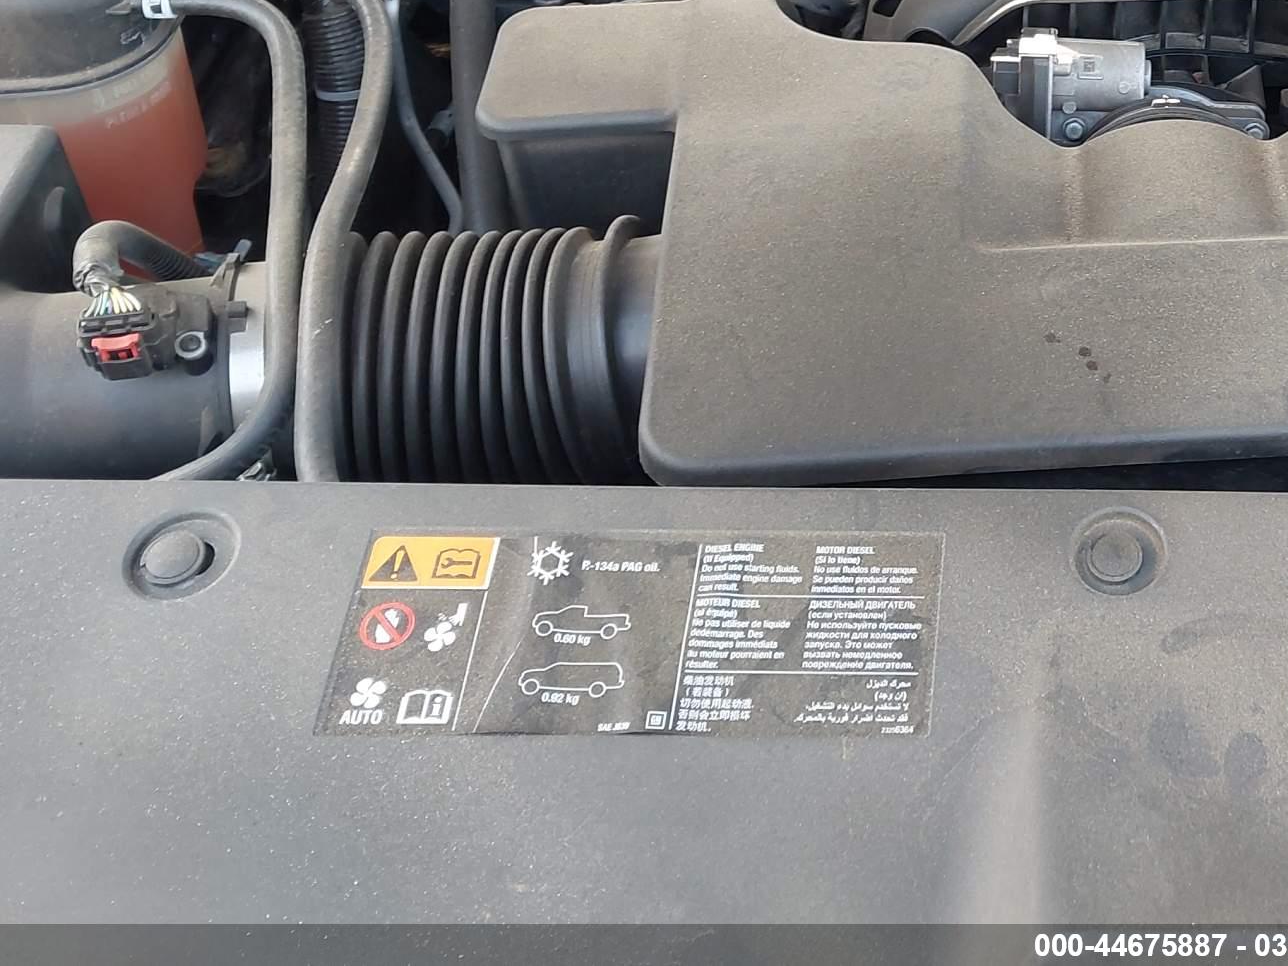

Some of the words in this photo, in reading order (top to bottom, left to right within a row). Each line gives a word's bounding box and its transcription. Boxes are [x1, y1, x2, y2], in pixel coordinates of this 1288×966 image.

[704, 544, 732, 553] DIESEL
[734, 543, 764, 552] ENGINE
[816, 546, 845, 554] MOTOR
[846, 546, 875, 554] DIESEL
[703, 554, 713, 563] (If
[714, 554, 754, 564] Equipped)
[814, 556, 826, 564] (Si
[827, 556, 836, 564] lo
[838, 556, 860, 565] tiene)
[582, 560, 620, 572] R-134a
[620, 561, 643, 572] PAG
[644, 562, 661, 572] oil.
[702, 564, 713, 572] Do
[714, 564, 727, 572] not
[744, 564, 775, 574] starting
[776, 565, 800, 573] fluids.
[842, 566, 868, 574] fluidos
[870, 566, 881, 574] de
[882, 567, 918, 576] arranque.
[700, 574, 741, 582] Immediate
[742, 575, 770, 584] engine
[770, 575, 803, 584] damage
[812, 575, 823, 583] Se
[824, 575, 854, 584] pueden
[854, 576, 889, 584] producir
[889, 575, 914, 584] daños
[714, 583, 739, 592] result.
[811, 585, 854, 593] inmediatos
[696, 598, 731, 607] MOTEUR
[731, 599, 760, 608] DIESEL
[808, 600, 864, 610] ДИЗЕЛЬНЫЙ
[864, 600, 916, 610] ДВИГАТЕЛЬ
[692, 618, 704, 627] Ne
[704, 619, 720, 628] pas
[721, 620, 750, 628] utiliser
[762, 620, 791, 630] liquide
[806, 620, 819, 629] Не
[820, 622, 877, 630] используйте
[878, 622, 922, 631] пусковые
[747, 630, 764, 638] Des
[806, 632, 850, 640] жидкости
[850, 632, 868, 640] для
[870, 632, 918, 640] холодного
[554, 634, 576, 644] 0.60
[576, 634, 591, 646] kg
[688, 639, 734, 650] dommages
[734, 640, 778, 649] immédiats
[804, 642, 842, 650] запуска.
[844, 640, 862, 650] Это
[686, 650, 698, 658] au
[700, 650, 730, 659] moteur
[730, 650, 772, 660] pourraient
[685, 660, 720, 668] résulter.
[541, 692, 564, 703] 0.92
[565, 693, 580, 706] kg
[338, 709, 383, 724] AUTO
